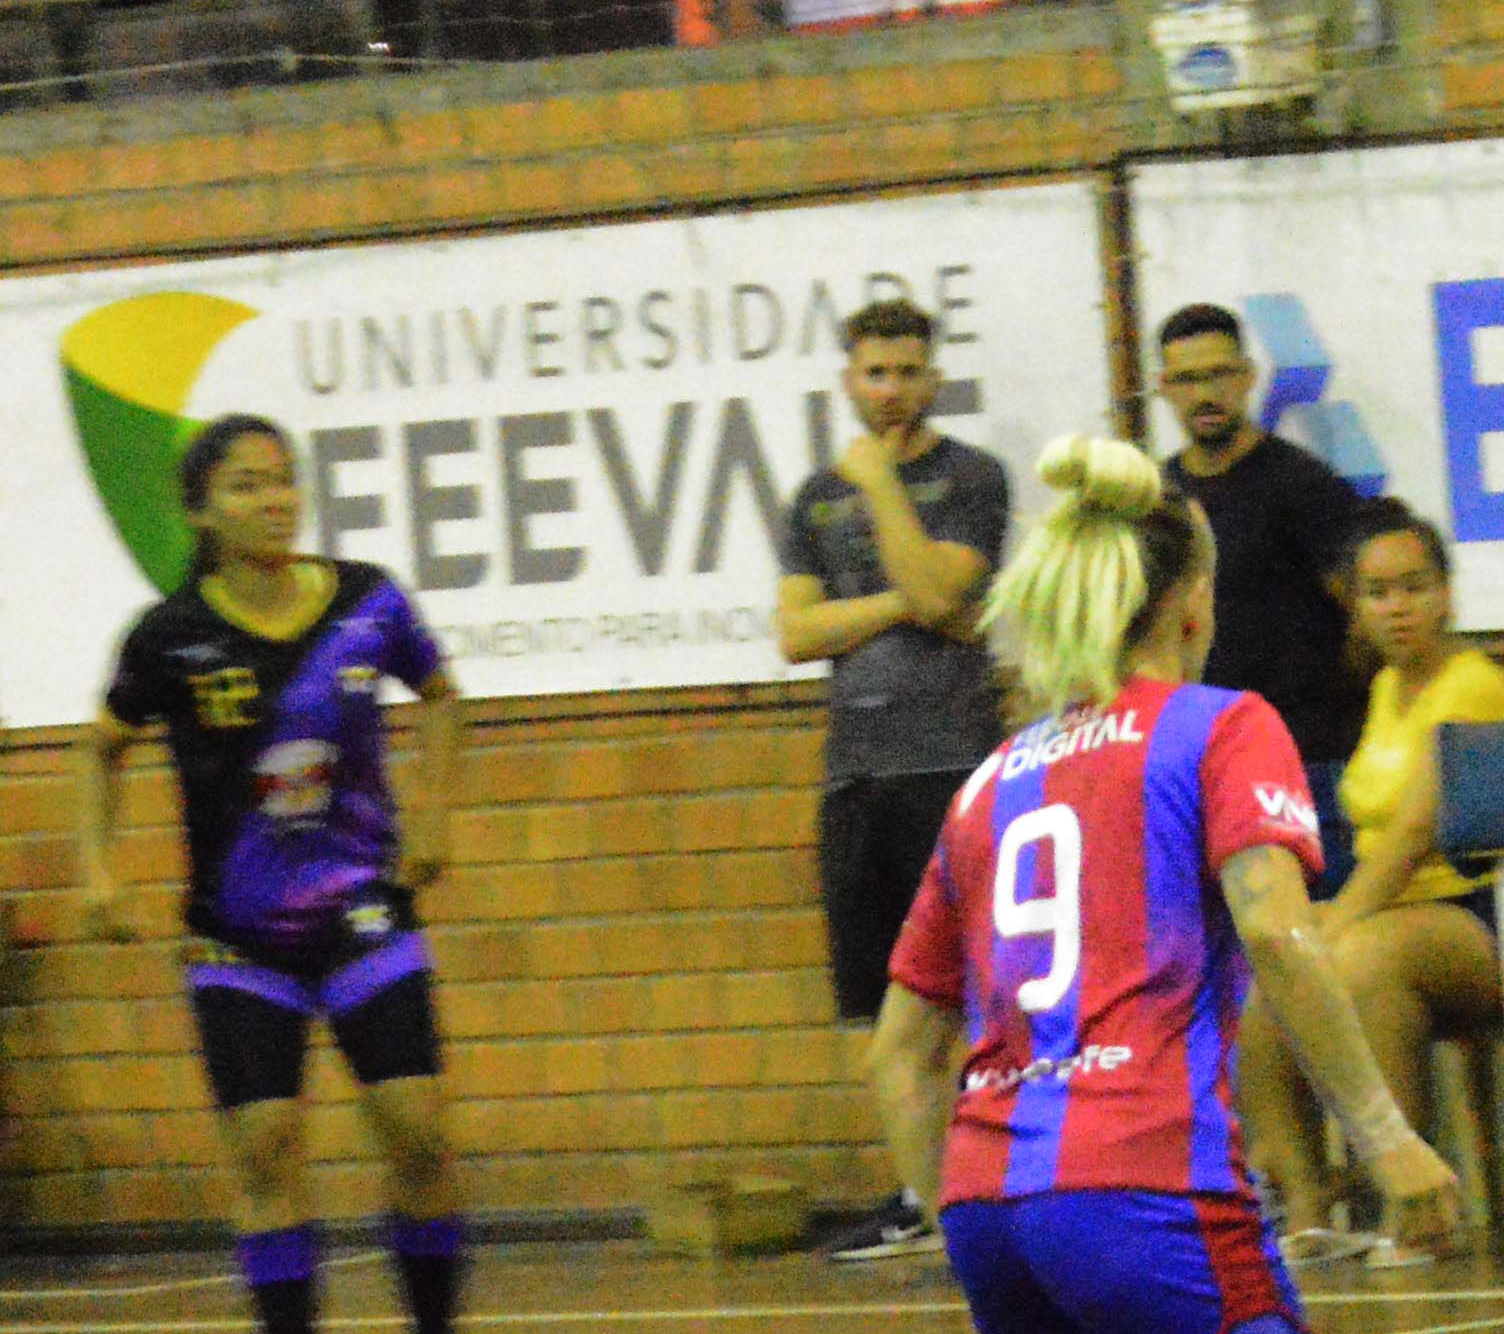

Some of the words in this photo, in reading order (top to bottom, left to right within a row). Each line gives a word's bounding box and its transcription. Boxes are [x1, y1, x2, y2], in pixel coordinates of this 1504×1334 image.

[298, 264, 978, 395] UNIVERSIDAE
[309, 377, 984, 591] FEEVA
[1002, 709, 1144, 780] DIGITAL
[993, 802, 1083, 1012] 9
